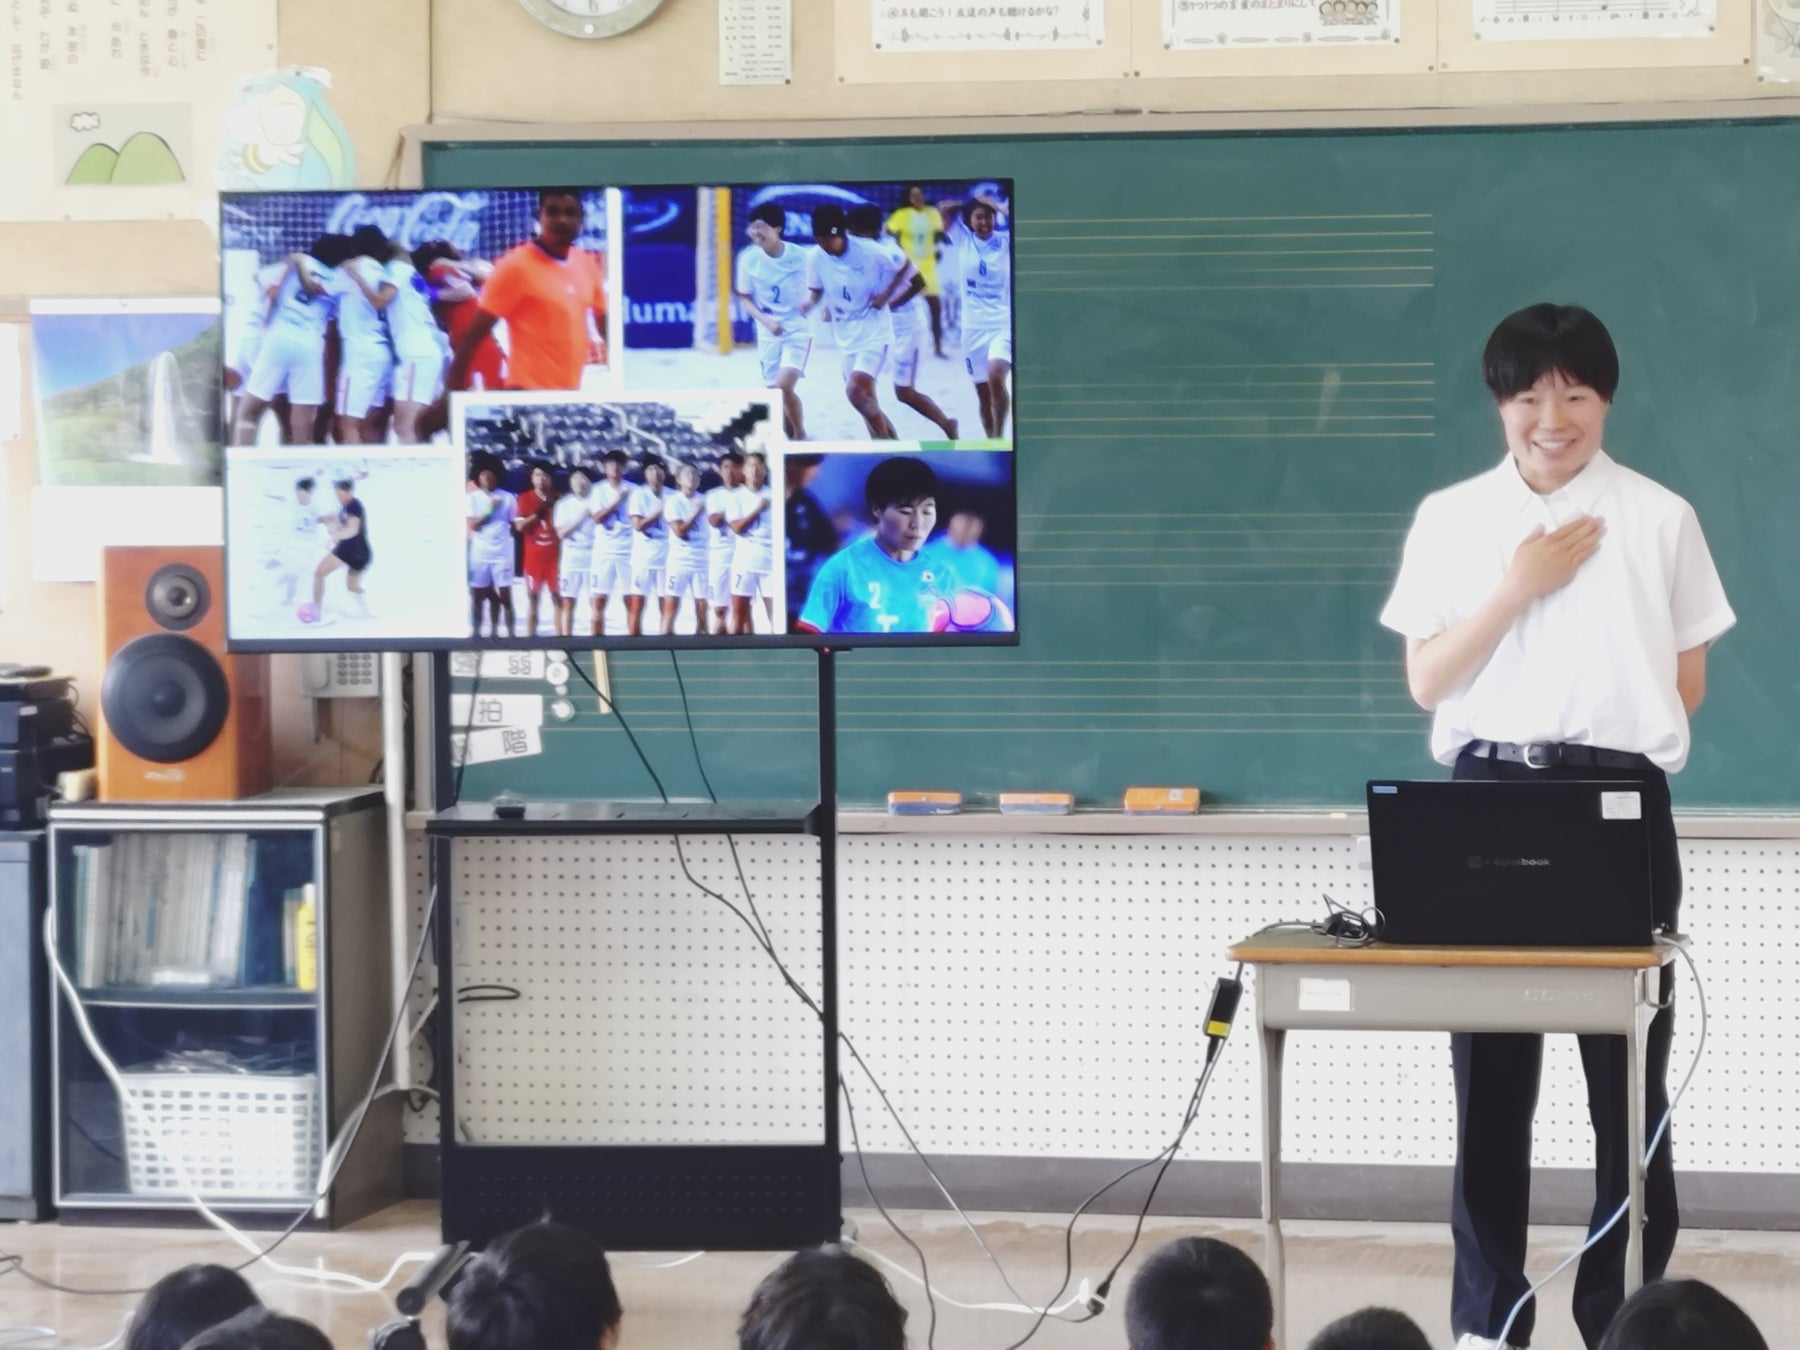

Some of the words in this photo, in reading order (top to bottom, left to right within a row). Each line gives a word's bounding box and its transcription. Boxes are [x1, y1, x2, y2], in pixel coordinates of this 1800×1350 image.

[868, 581, 882, 609] 2
[478, 698, 503, 723] 拍
[502, 728, 528, 755] 階
